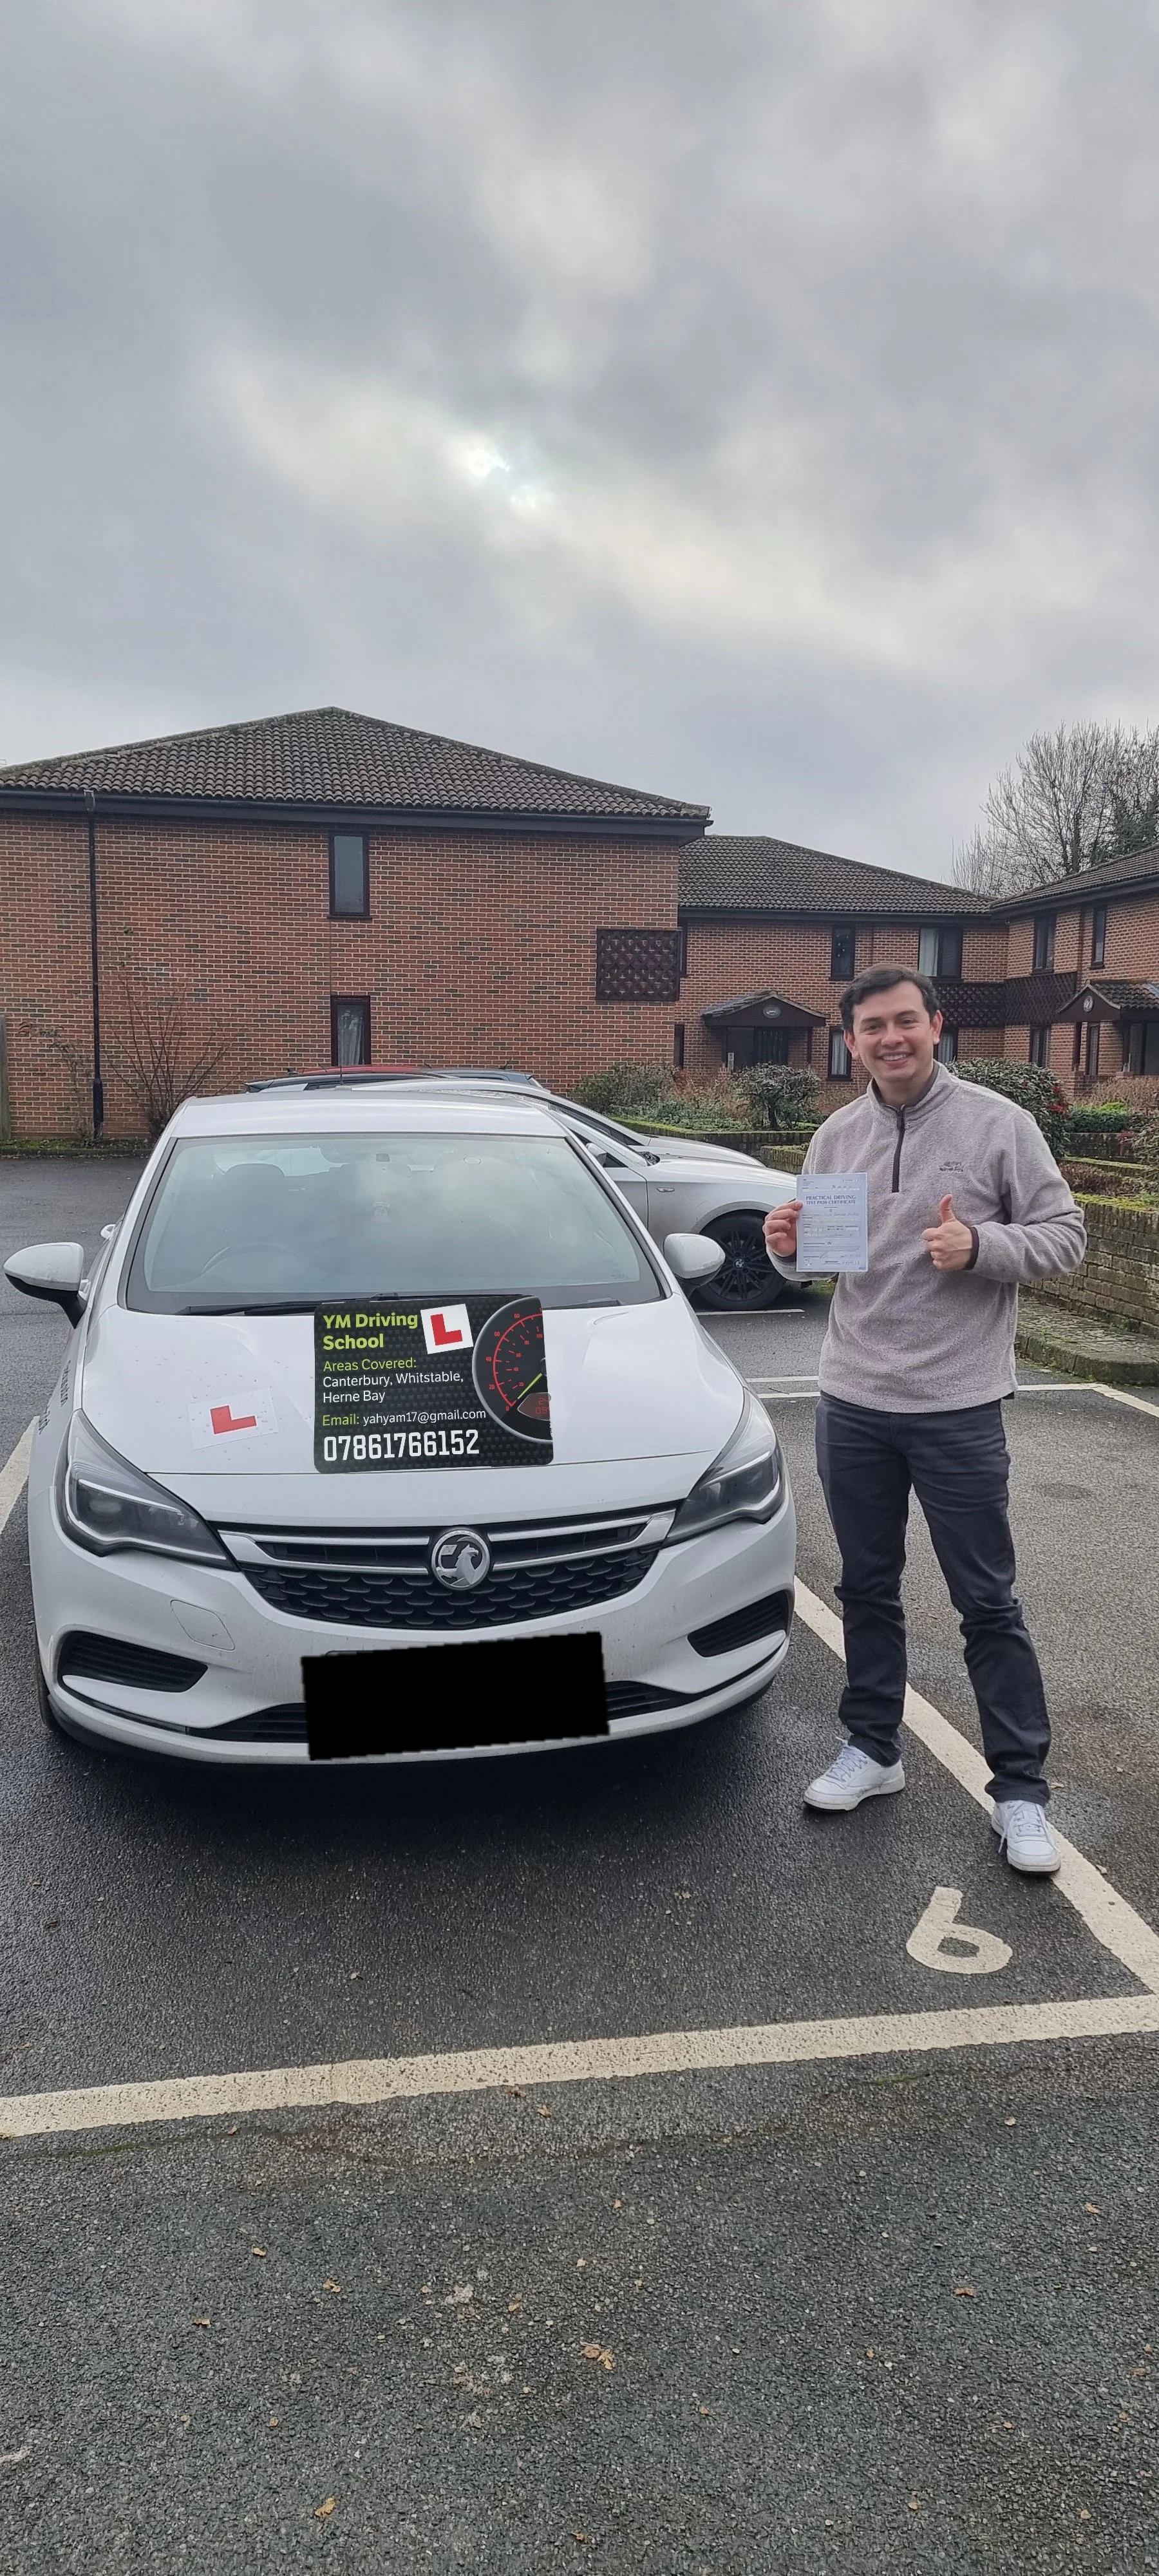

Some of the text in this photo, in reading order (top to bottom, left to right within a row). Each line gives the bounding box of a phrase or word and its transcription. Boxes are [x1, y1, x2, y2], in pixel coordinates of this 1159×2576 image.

[323, 1312, 418, 1329] YM Driving
[430, 1313, 463, 1346] L
[323, 1333, 384, 1350] School
[323, 1357, 417, 1372] Areas Covered:
[323, 1371, 464, 1387] Canterbury, Whitstable,
[323, 1390, 386, 1403] Herne Bay
[210, 1405, 257, 1435] L
[323, 1410, 486, 1426] Email: yahyam17@gmail.com
[323, 1429, 480, 1461] 07861766152
[906, 1886, 1013, 1975] 6
